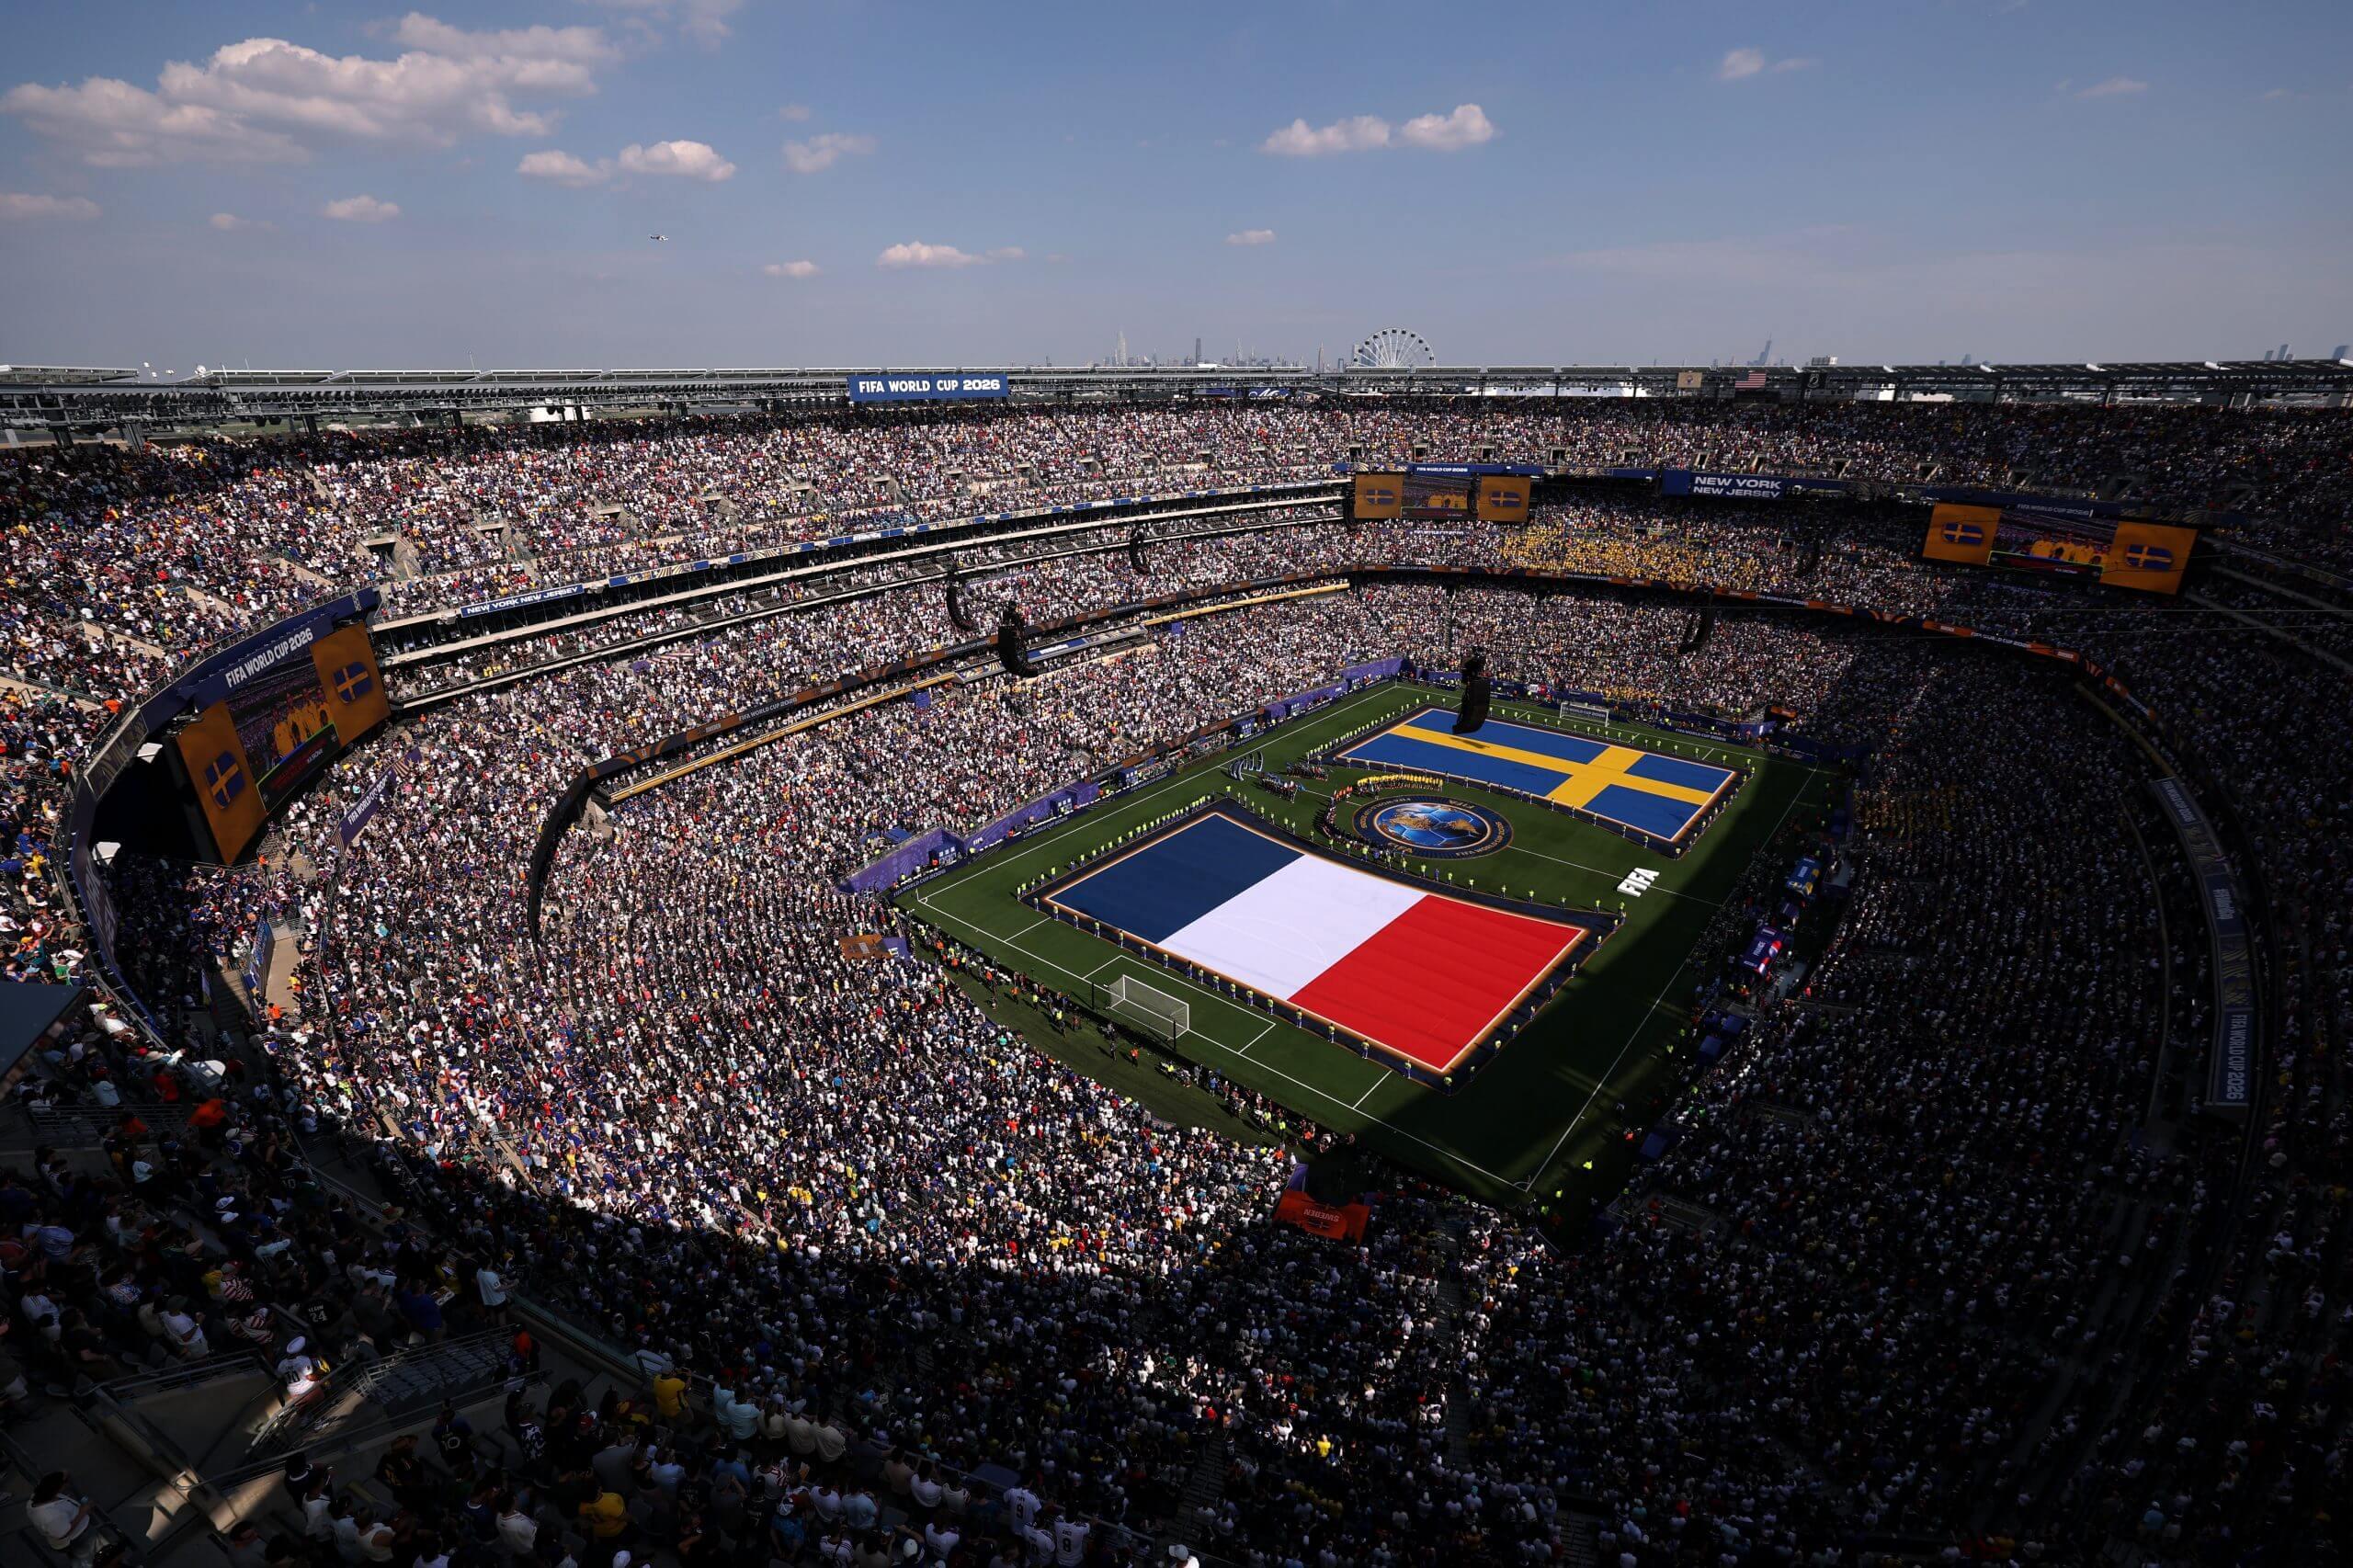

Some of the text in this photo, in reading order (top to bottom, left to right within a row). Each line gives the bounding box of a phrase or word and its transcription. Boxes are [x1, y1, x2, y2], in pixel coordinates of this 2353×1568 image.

[858, 379, 1001, 392] FIFA WORLD CUP 2026
[1694, 476, 1782, 490] NEW YORK
[1693, 486, 1780, 498] NEW JERSEY
[467, 586, 578, 615] NEW YORK NEW JERSEY
[225, 628, 313, 688] FIFA WORLD CUP 2026
[750, 707, 769, 717] WORLD
[770, 703, 780, 711] CUP
[1685, 729, 1700, 737] WORLD
[348, 808, 359, 824] FIFA
[358, 796, 372, 813] WORLD
[903, 881, 919, 892] WORLD
[1616, 868, 1660, 897] FIFA
[2226, 1014, 2248, 1100] FIFA WORLD CUP 2026
[1303, 1209, 1339, 1222] SWEDEN
[1063, 1538, 1071, 1553] 8
